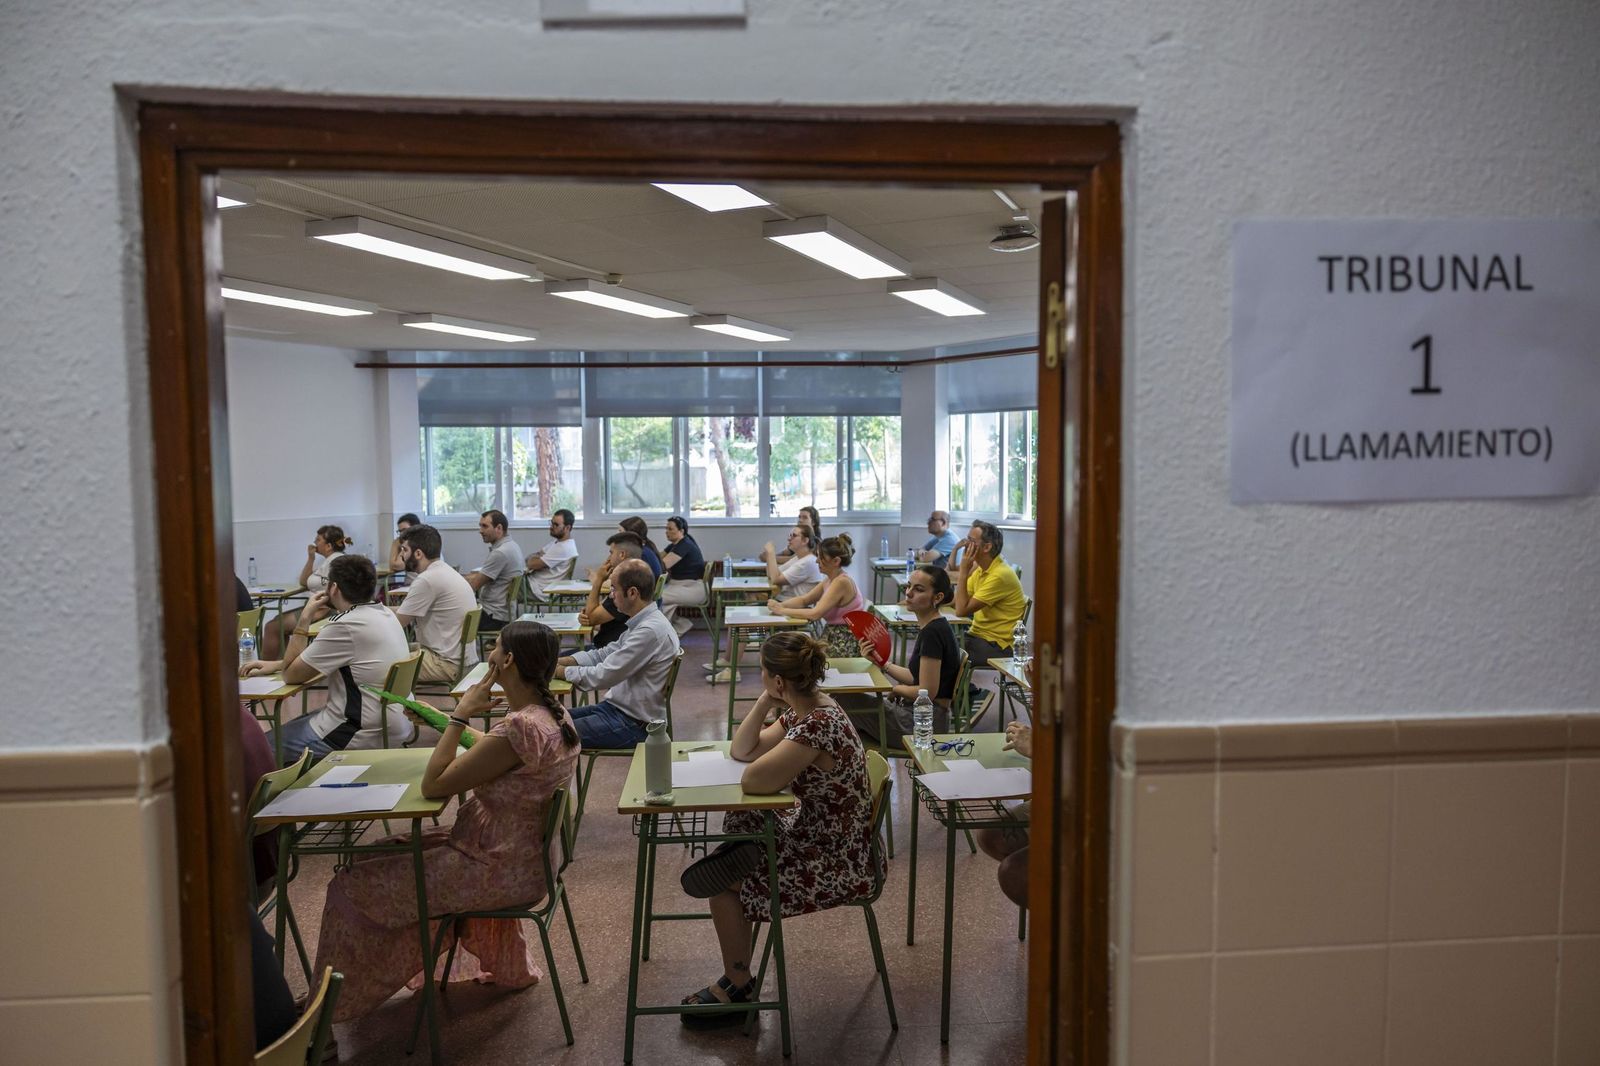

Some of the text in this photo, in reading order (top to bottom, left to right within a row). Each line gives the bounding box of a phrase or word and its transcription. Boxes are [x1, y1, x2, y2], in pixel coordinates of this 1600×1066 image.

[1317, 254, 1535, 293] TRIBUNAL
[1410, 334, 1442, 395] 1
[1290, 425, 1553, 468] (LLAMAMIENTO)
